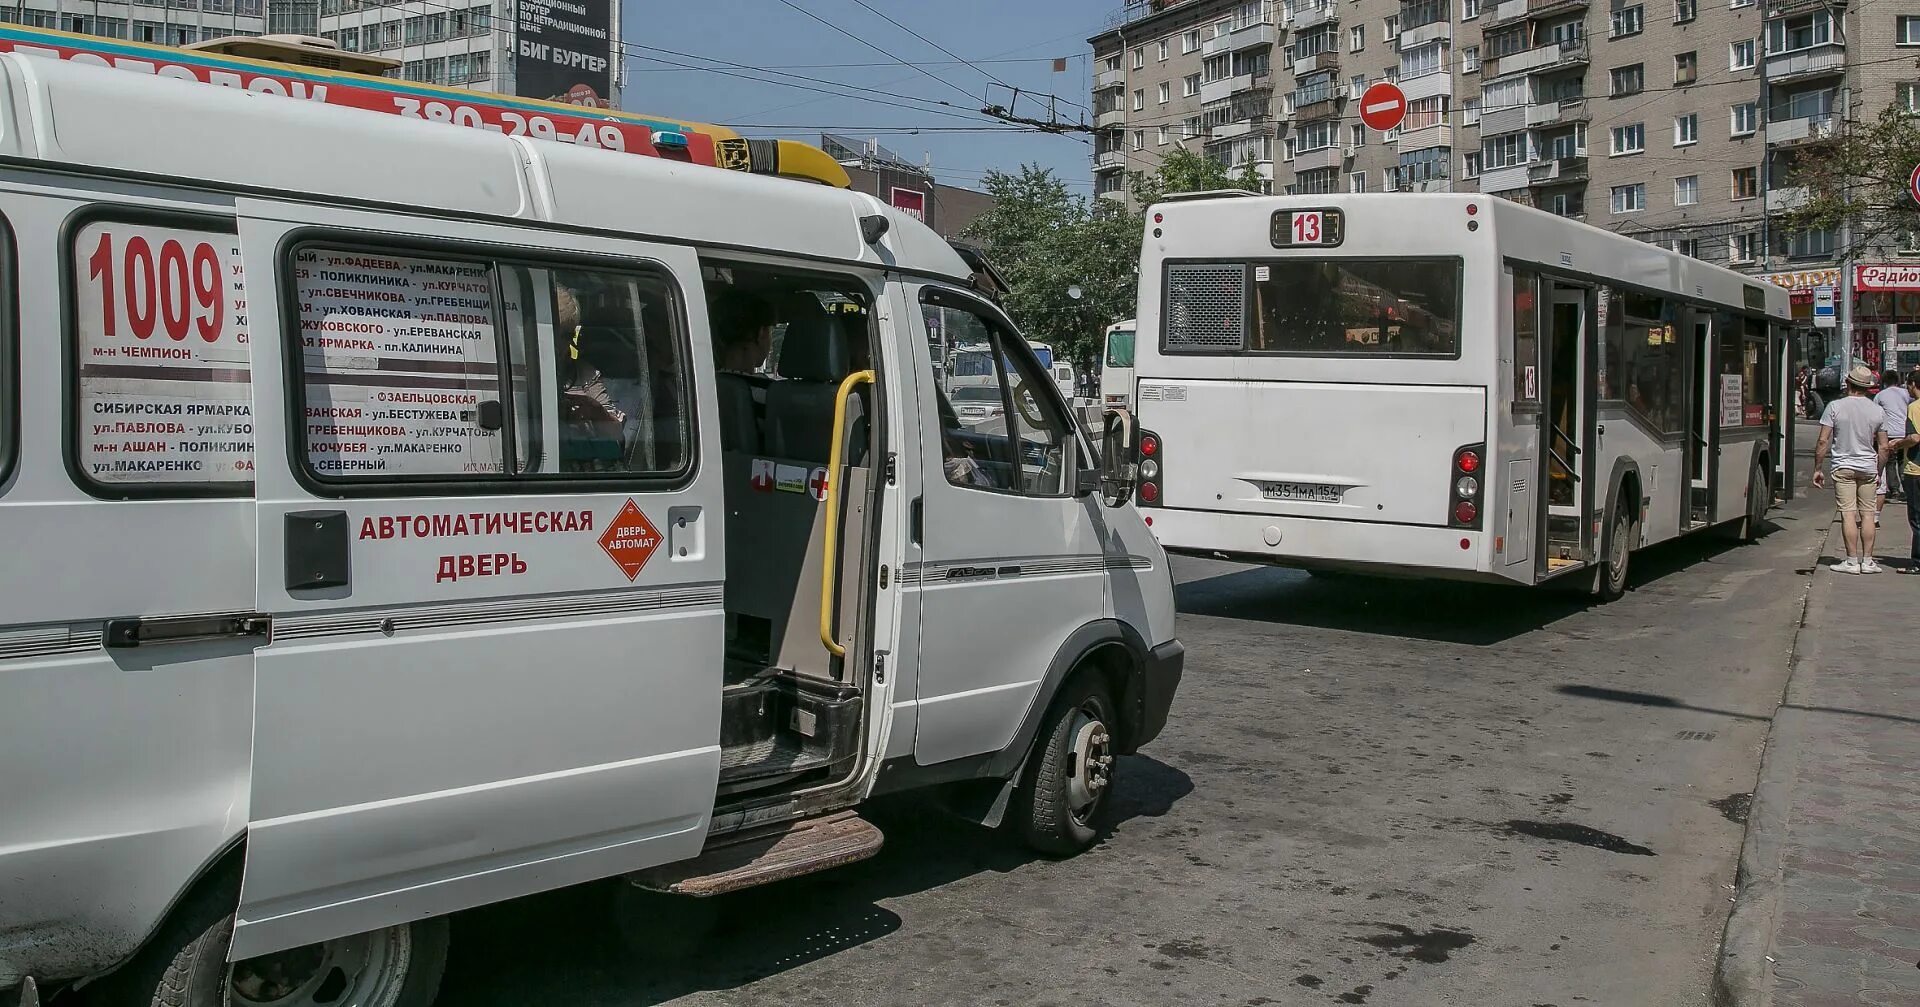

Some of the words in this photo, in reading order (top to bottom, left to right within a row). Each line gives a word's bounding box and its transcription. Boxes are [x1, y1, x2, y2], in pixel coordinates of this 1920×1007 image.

[520, 1, 550, 16] БУРГЕР
[520, 11, 532, 21] ПО
[534, 15, 607, 40] НЕТРАДИЦИОННОЙ
[520, 39, 550, 61] БИГ
[553, 47, 607, 73] БУРГЕР
[1293, 213, 1320, 242] 13
[327, 257, 401, 271] ул.ФАДЕЕВА
[89, 232, 225, 343] 1009
[320, 271, 409, 287] ПОЛИКЛИНИКА
[423, 281, 490, 294] ул.КУРЧАТО
[308, 288, 406, 304] ул.СВЕЧНИКОВА
[323, 305, 411, 319] ул.ХОВАНСКАЯ
[421, 312, 489, 325] ул.ПАВЛОВА
[393, 327, 481, 340] ул.ЕРЕВАНСКАЯ
[93, 347, 116, 356] м-н
[121, 346, 192, 360] ЧЕМПИОН
[319, 338, 375, 350] ЯРМАРКА
[384, 342, 463, 355] пл.КАЛИНИНА
[1526, 367, 1535, 397] 13
[93, 402, 182, 415] СИБИРСКАЯ
[187, 405, 251, 416] ЯРМАРКА
[372, 409, 457, 421] ул.БЕСТУЖЕВА
[93, 422, 186, 435] ул.ПАВЛОВА
[197, 424, 253, 436] ул.КУБО
[308, 424, 406, 438] ГРЕБЕНЩИКОВА
[415, 427, 496, 439] ул.КУРЧАТОВА
[93, 444, 118, 453] м-н
[122, 442, 167, 453] АШАН
[377, 443, 462, 455] ул.МАКАРЕНКО
[93, 460, 203, 473] ул.МАКАРЕНКО
[1319, 486, 1338, 497] 154
[359, 510, 594, 540] АВТОМАТИЧЕСКАЯ
[616, 526, 647, 539] ДВЕРЬ
[608, 538, 655, 550] АВТОМАТ
[436, 552, 528, 583] ДВЕРЬ
